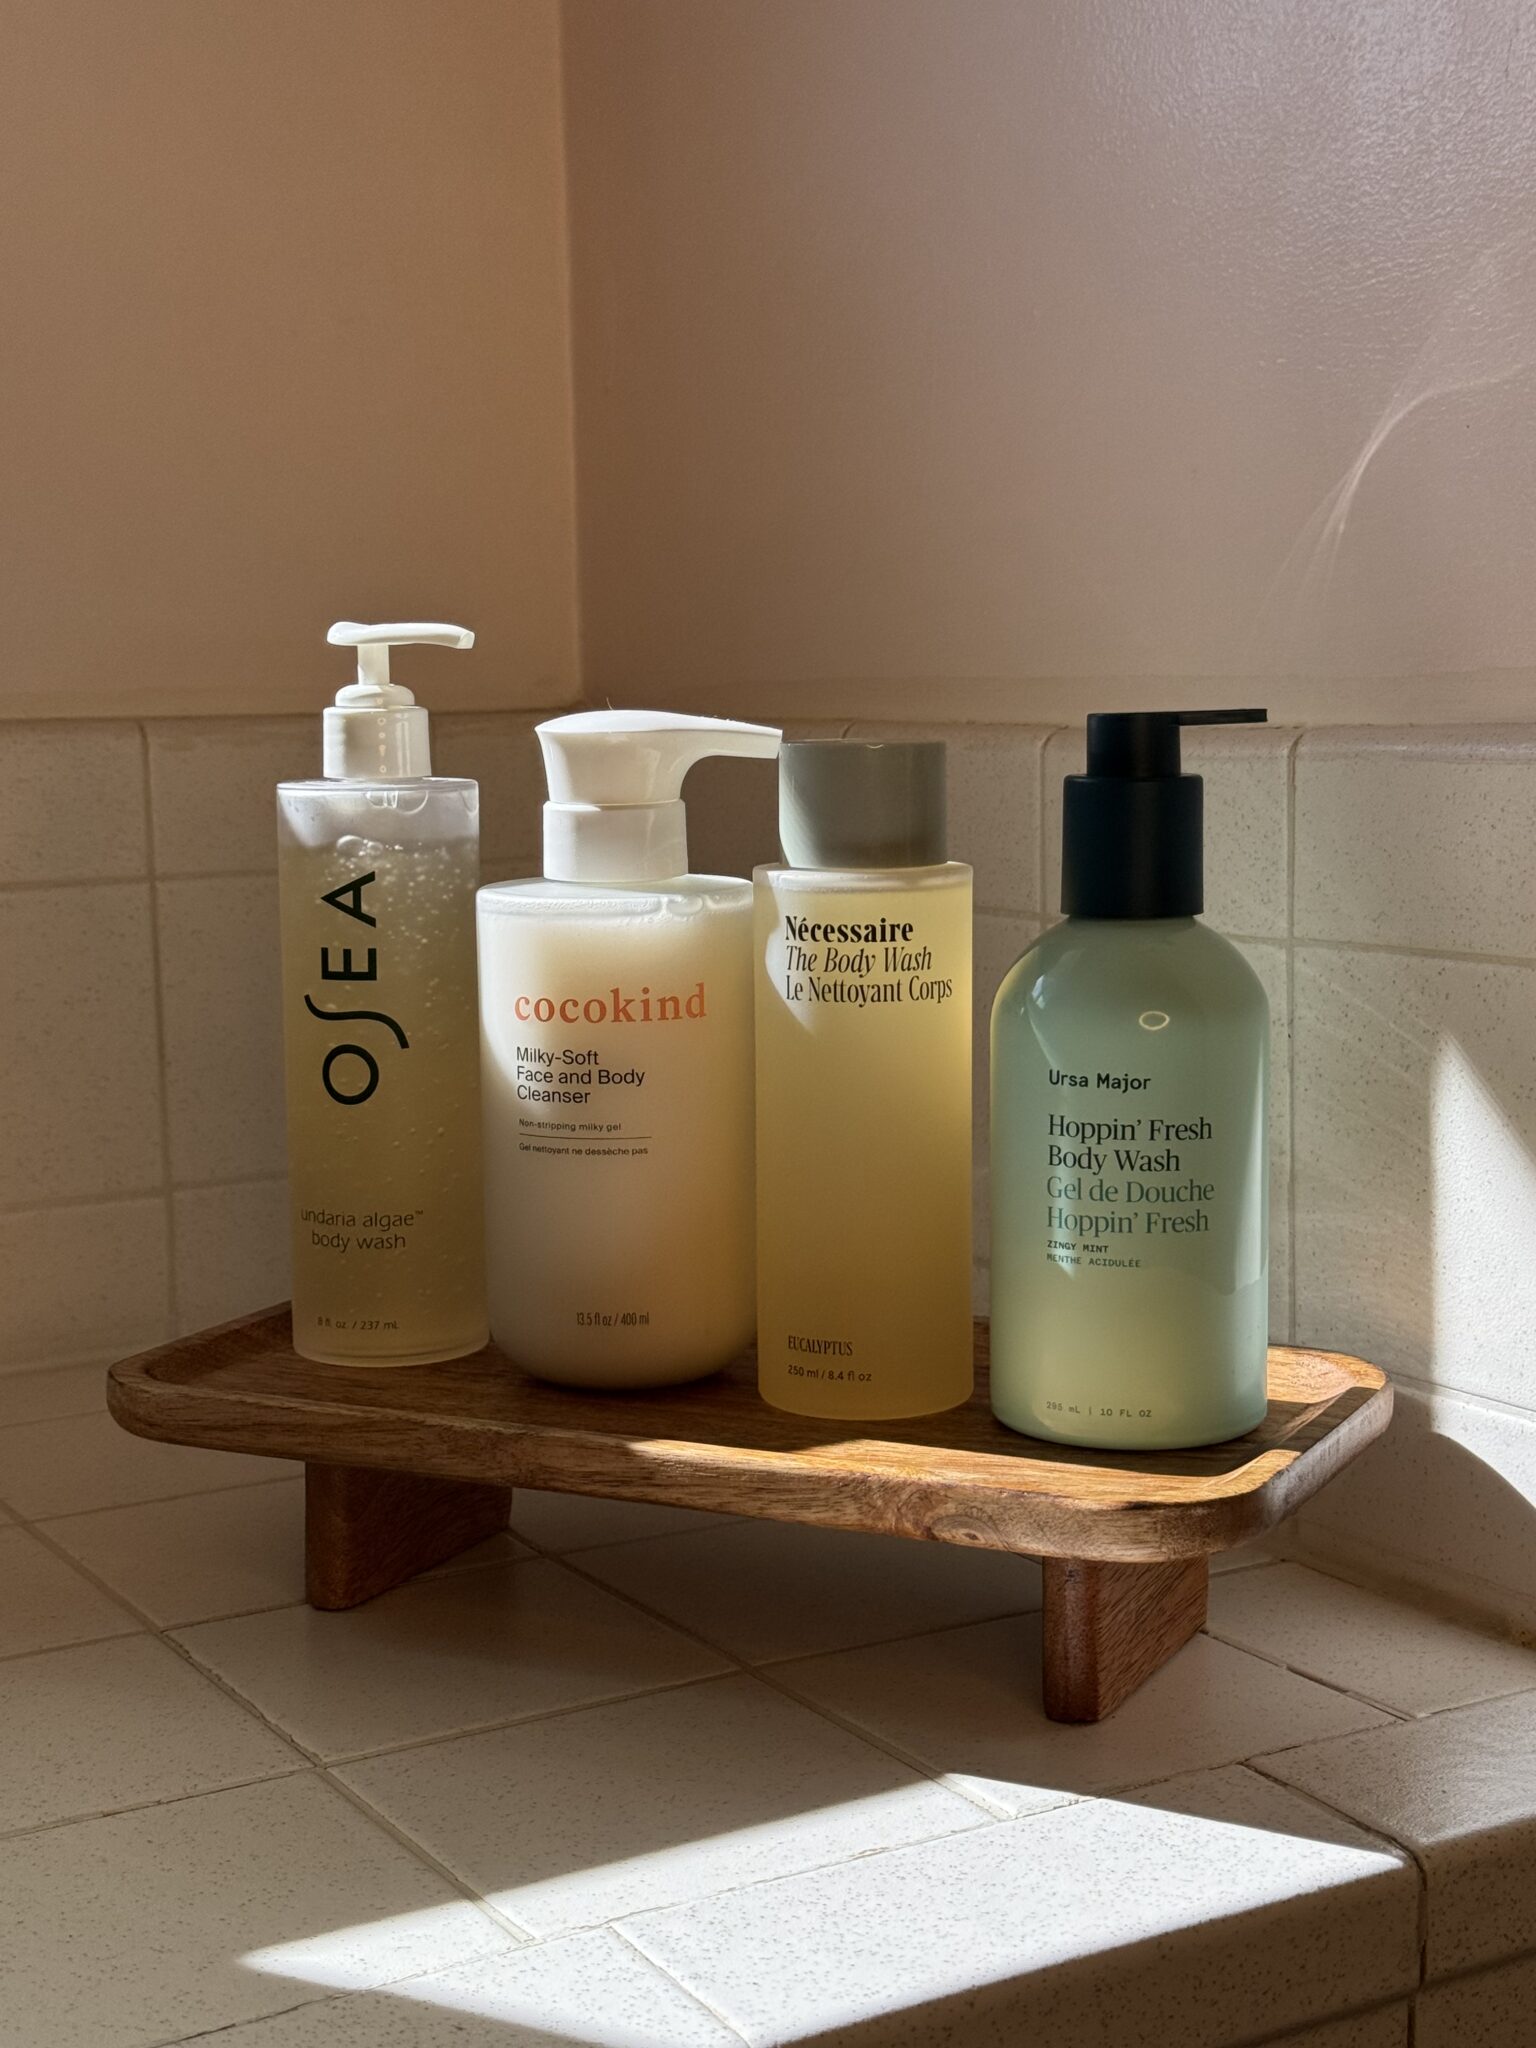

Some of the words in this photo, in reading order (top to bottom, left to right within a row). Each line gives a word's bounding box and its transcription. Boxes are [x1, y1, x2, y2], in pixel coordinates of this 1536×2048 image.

[785, 915, 914, 943] Nécessaire
[786, 945, 817, 972] The
[824, 947, 876, 978] Body
[884, 946, 932, 973] Wash
[304, 871, 410, 1105] OSEA
[786, 975, 804, 1001] Le
[808, 976, 902, 1008] Nettoyant
[909, 975, 953, 1004] Corps
[514, 982, 707, 1024] cocokind
[516, 1046, 600, 1067] Milky-Soft
[517, 1066, 553, 1083] Face
[558, 1070, 592, 1085] and
[598, 1069, 646, 1087] Body
[1049, 1069, 1089, 1088] Ursa
[1096, 1073, 1152, 1094] Major
[517, 1085, 591, 1104] Cleanser
[518, 1118, 577, 1132] Non-stripping
[578, 1122, 604, 1132] milky
[606, 1123, 622, 1132] gel
[1149, 1116, 1213, 1142] Fresh
[519, 1142, 531, 1151] Gel
[532, 1145, 570, 1155] nettoyant
[571, 1147, 583, 1155] ne
[631, 1147, 649, 1156] pas
[1048, 1144, 1107, 1175] Body
[1114, 1149, 1180, 1172] Wash
[1047, 1176, 1082, 1201] Gel
[1089, 1179, 1119, 1202] de
[1126, 1179, 1215, 1203] Douche
[301, 1208, 356, 1227] undaria
[1145, 1209, 1209, 1233] Fresh
[312, 1229, 350, 1253] body
[356, 1234, 406, 1250] wash
[1047, 1240, 1077, 1251] ZINGY
[1082, 1244, 1109, 1253] MINT
[1046, 1253, 1082, 1265] MENTHE
[360, 1321, 380, 1330] 237
[594, 1311, 601, 1326] fl
[602, 1315, 612, 1327] oz
[621, 1312, 637, 1327] 400
[639, 1311, 650, 1325] ml
[787, 1335, 853, 1356] EUCALYPTUS
[788, 1364, 804, 1377] 250
[806, 1368, 819, 1379] ml
[827, 1370, 844, 1381] 8.4
[858, 1372, 872, 1382] oz
[1046, 1401, 1063, 1411] 295
[1068, 1405, 1081, 1414] mL
[1100, 1408, 1113, 1417] 10
[1119, 1409, 1132, 1418] FL
[1139, 1409, 1152, 1418] OZ
